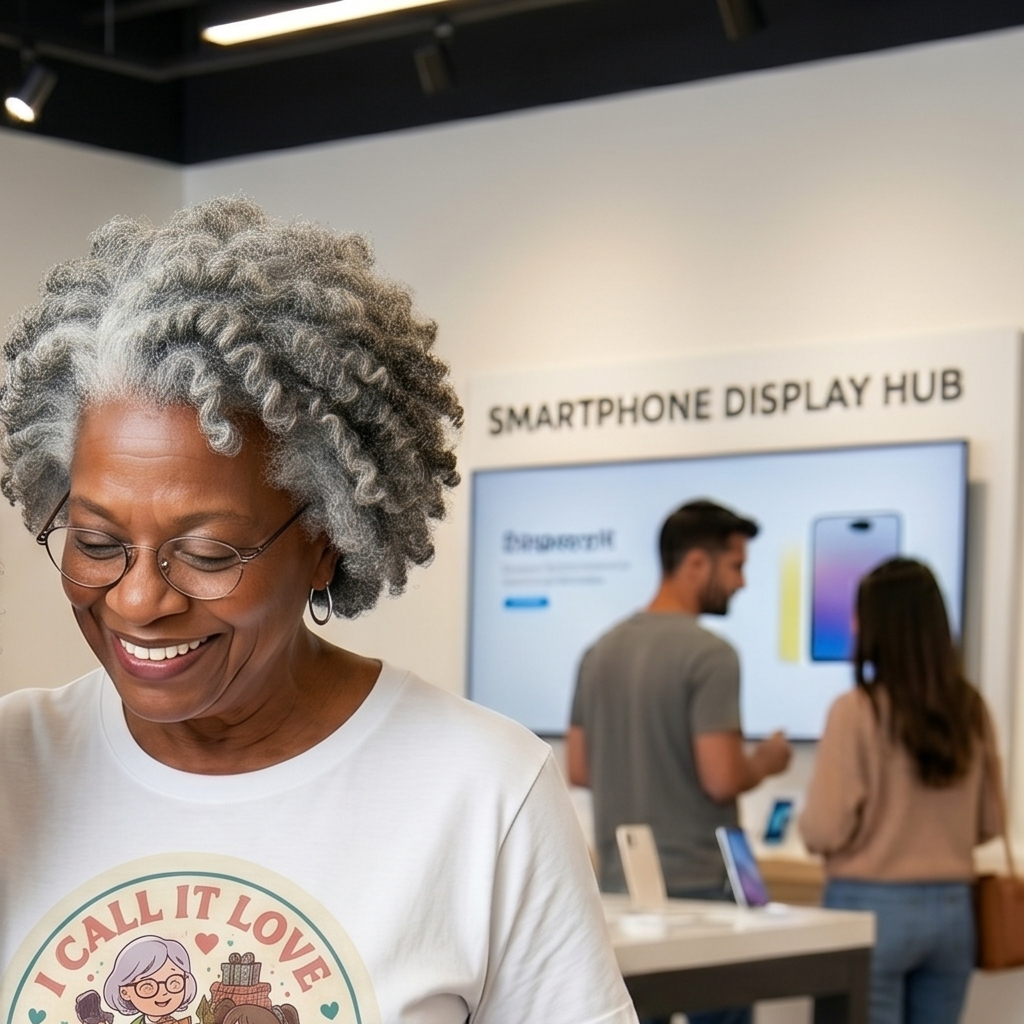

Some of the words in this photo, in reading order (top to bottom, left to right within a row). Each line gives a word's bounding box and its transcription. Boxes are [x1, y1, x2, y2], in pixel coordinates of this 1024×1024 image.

[488, 388, 711, 436] SMARTPHONE
[724, 376, 870, 418] DISPLAY
[884, 368, 964, 404] HUB
[34, 971, 66, 998] I
[55, 890, 164, 971] CALL
[176, 885, 221, 920] IT
[226, 894, 332, 993] LOVE
